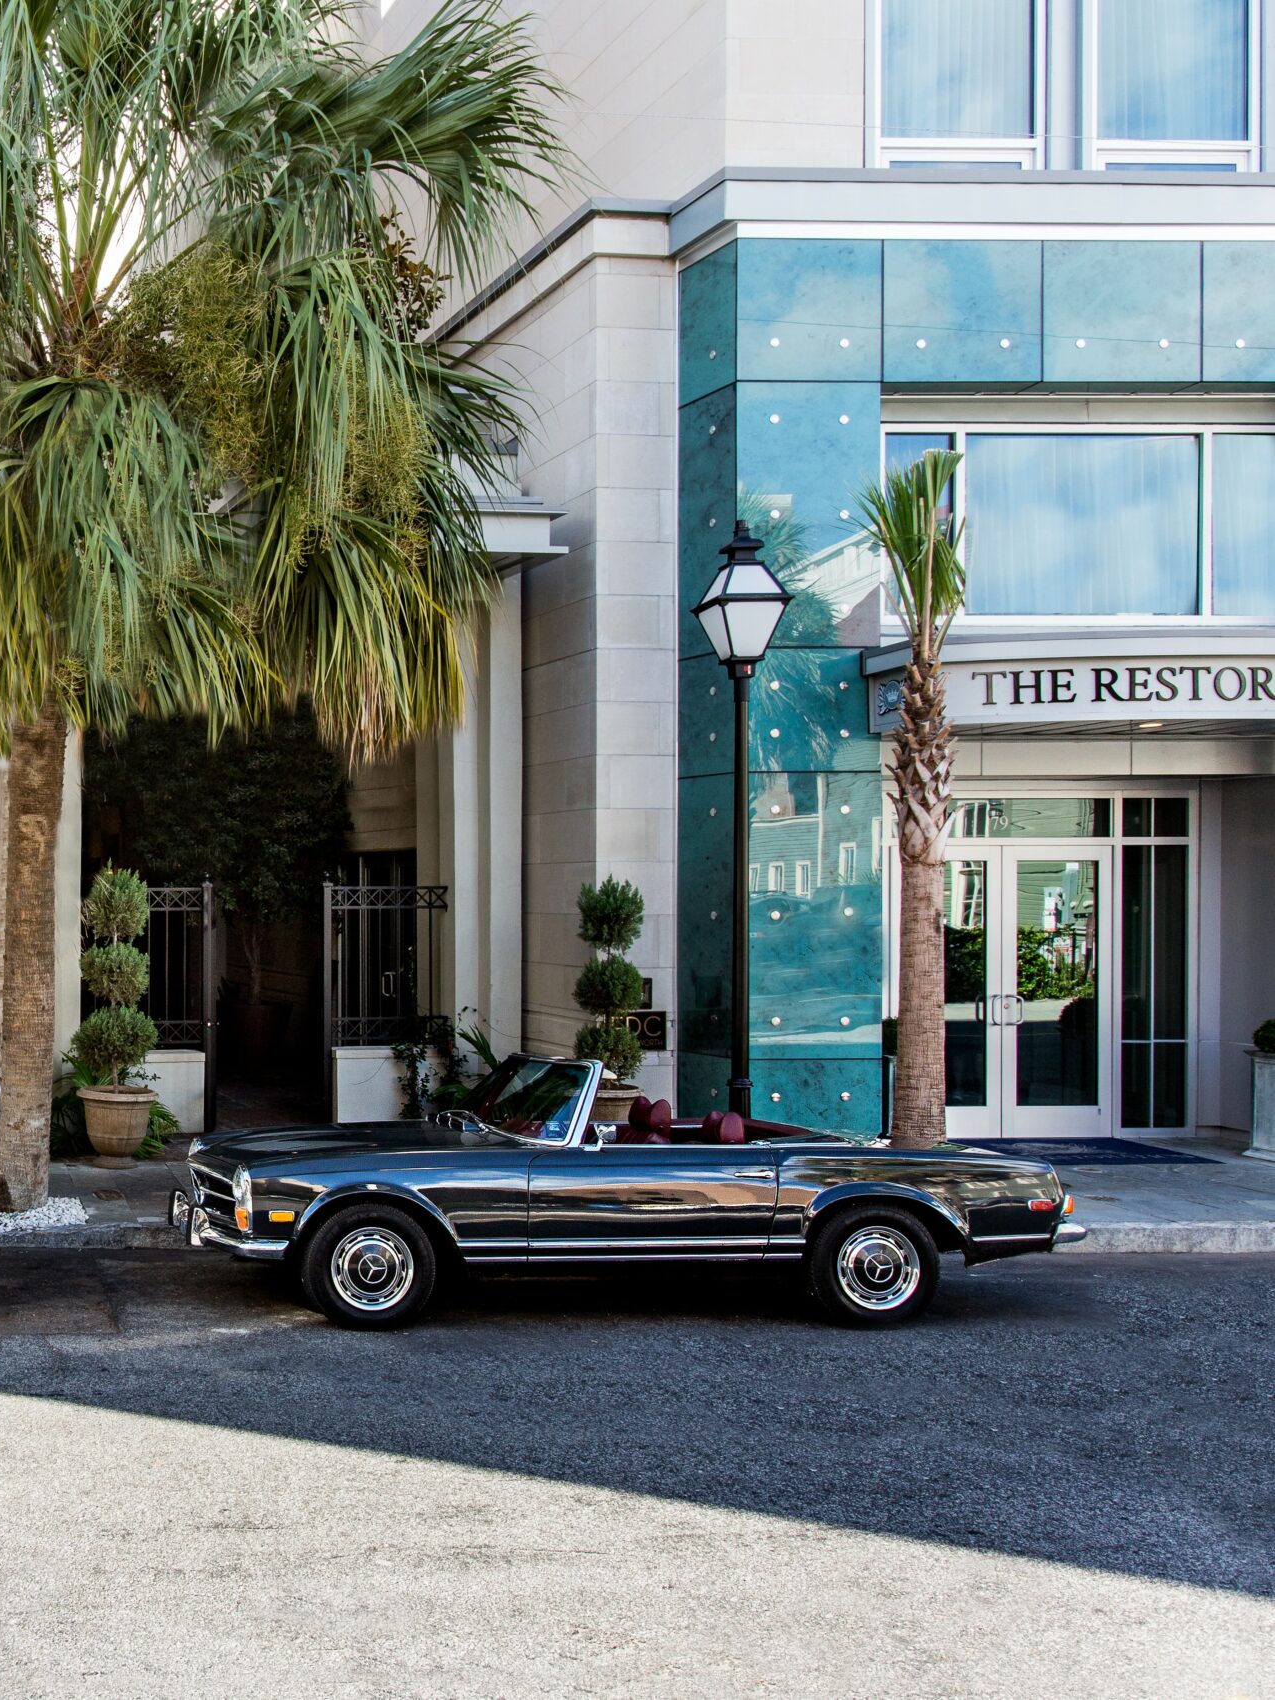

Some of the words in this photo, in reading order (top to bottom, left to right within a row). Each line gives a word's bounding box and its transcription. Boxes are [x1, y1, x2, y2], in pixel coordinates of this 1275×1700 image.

[971, 670, 1078, 706] THE
[1090, 666, 1275, 703] RESTOR
[990, 815, 1009, 831] 79
